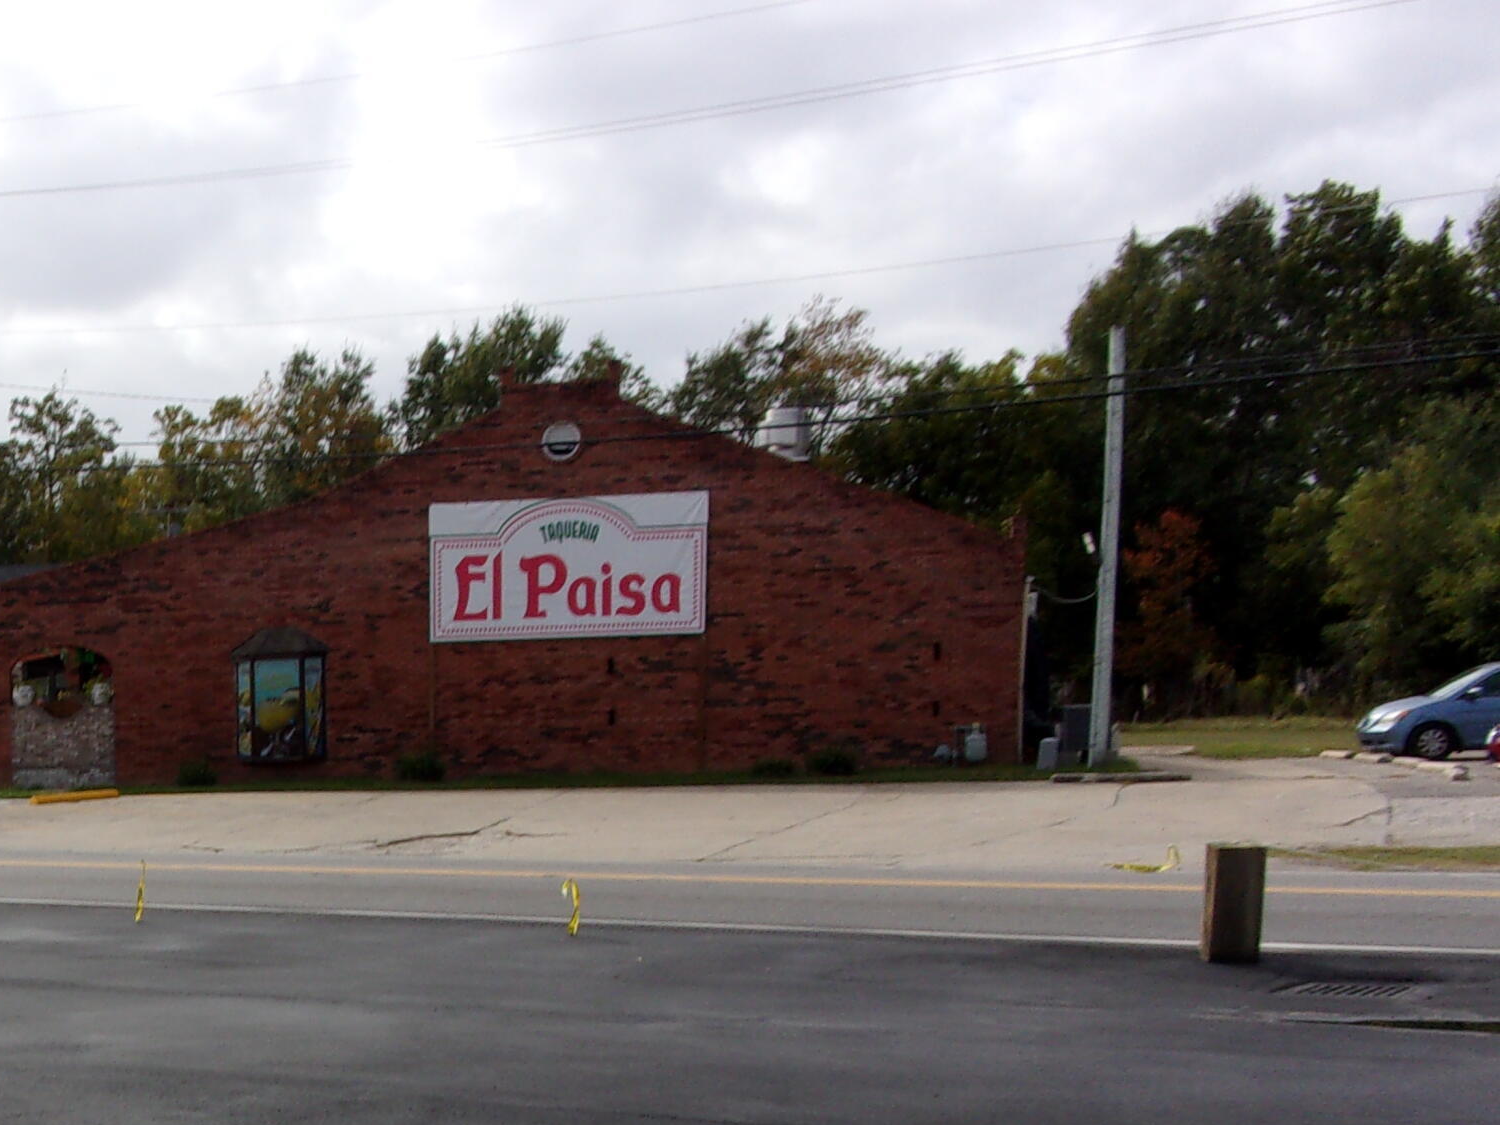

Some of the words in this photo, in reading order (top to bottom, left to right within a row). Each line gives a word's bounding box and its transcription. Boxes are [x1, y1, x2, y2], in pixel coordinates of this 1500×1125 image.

[539, 520, 600, 544] TAQUERIA
[453, 550, 503, 622] El
[519, 553, 682, 620] Paisa
